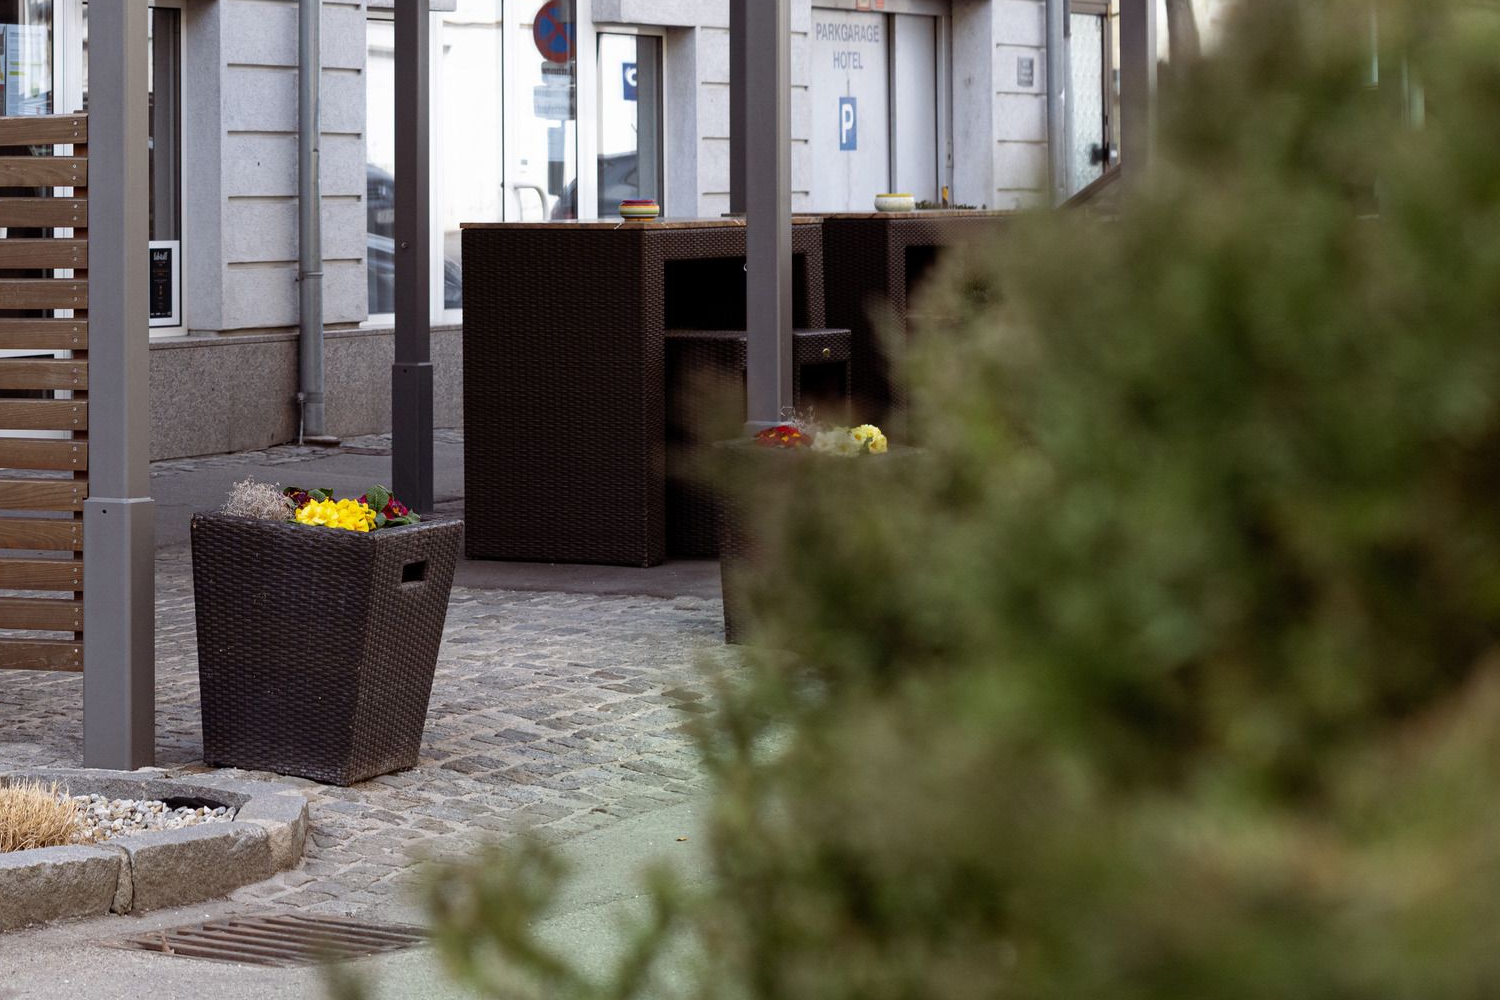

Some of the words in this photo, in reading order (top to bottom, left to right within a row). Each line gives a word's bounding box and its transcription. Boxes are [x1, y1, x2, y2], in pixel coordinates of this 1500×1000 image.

[816, 22, 880, 43] PARKGARAGE
[833, 51, 864, 70] HOTEL
[841, 103, 854, 144] P
